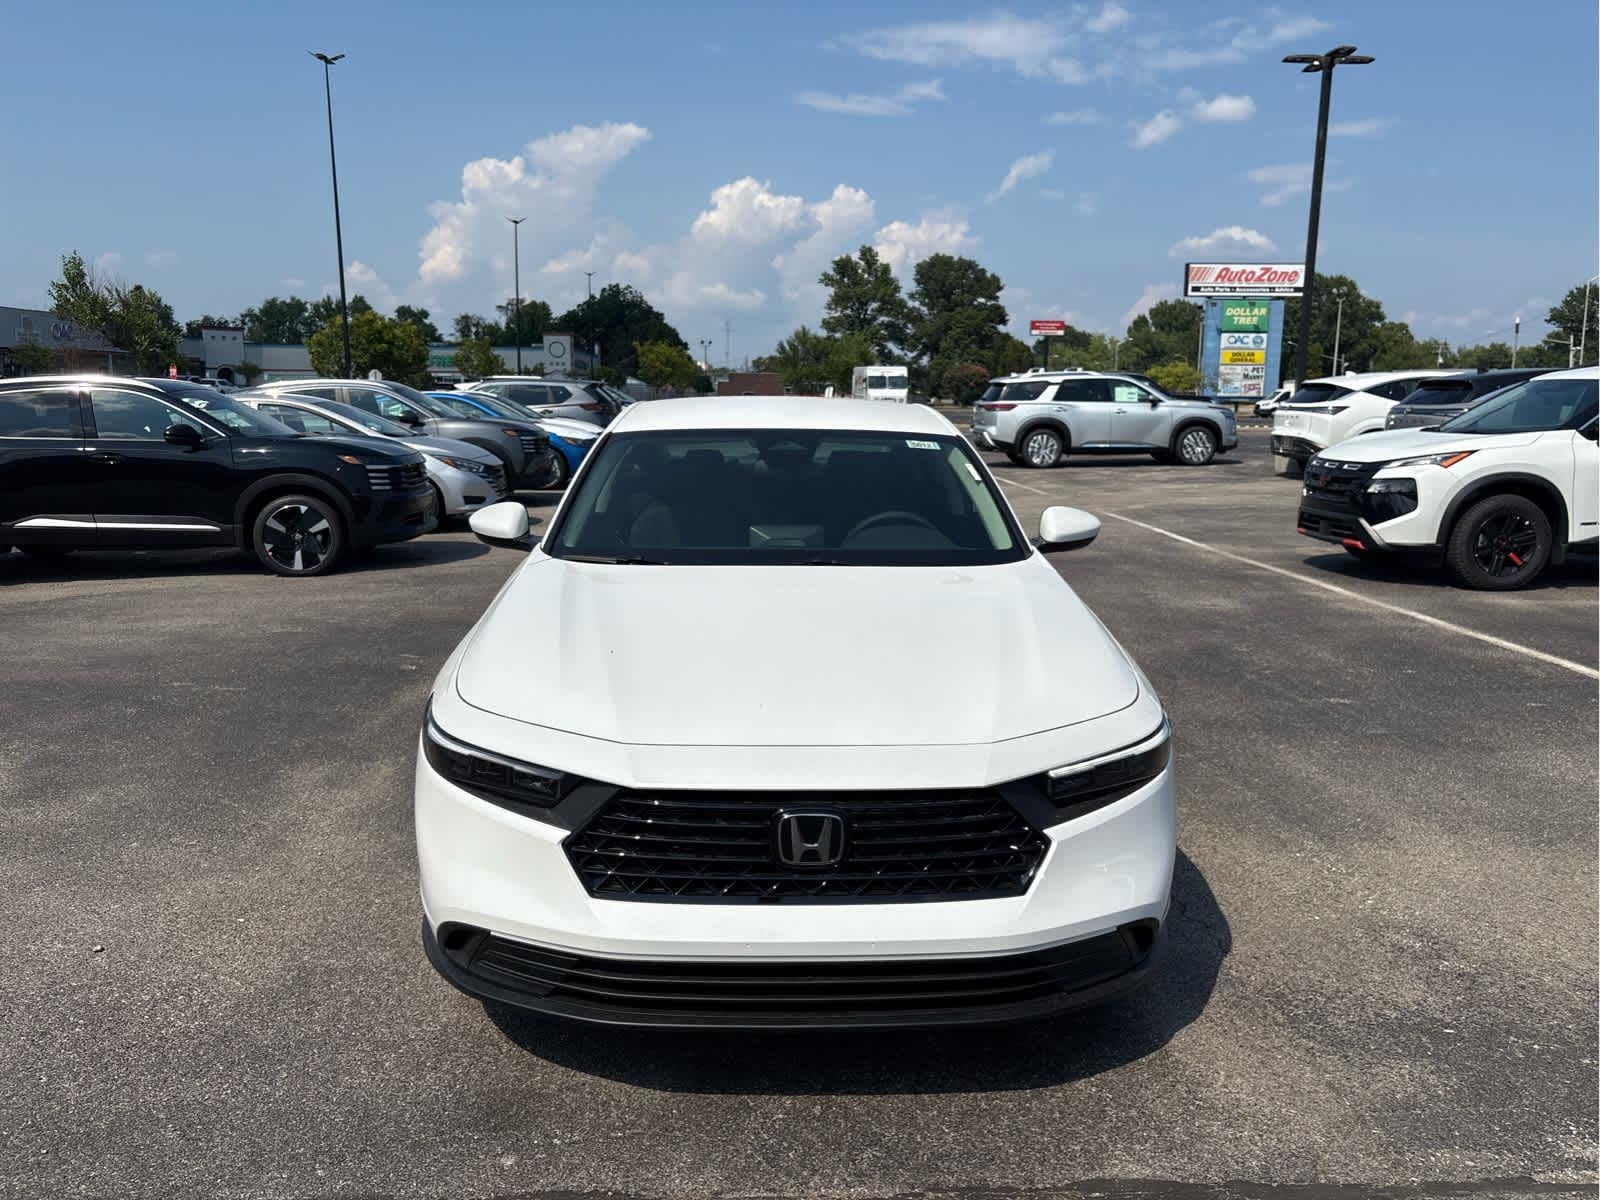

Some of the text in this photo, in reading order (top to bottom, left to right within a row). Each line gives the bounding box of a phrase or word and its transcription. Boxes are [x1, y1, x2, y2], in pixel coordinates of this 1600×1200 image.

[1215, 267, 1299, 282] AutoZone
[1225, 307, 1267, 316] DOLLAR
[1233, 316, 1258, 325] TREE
